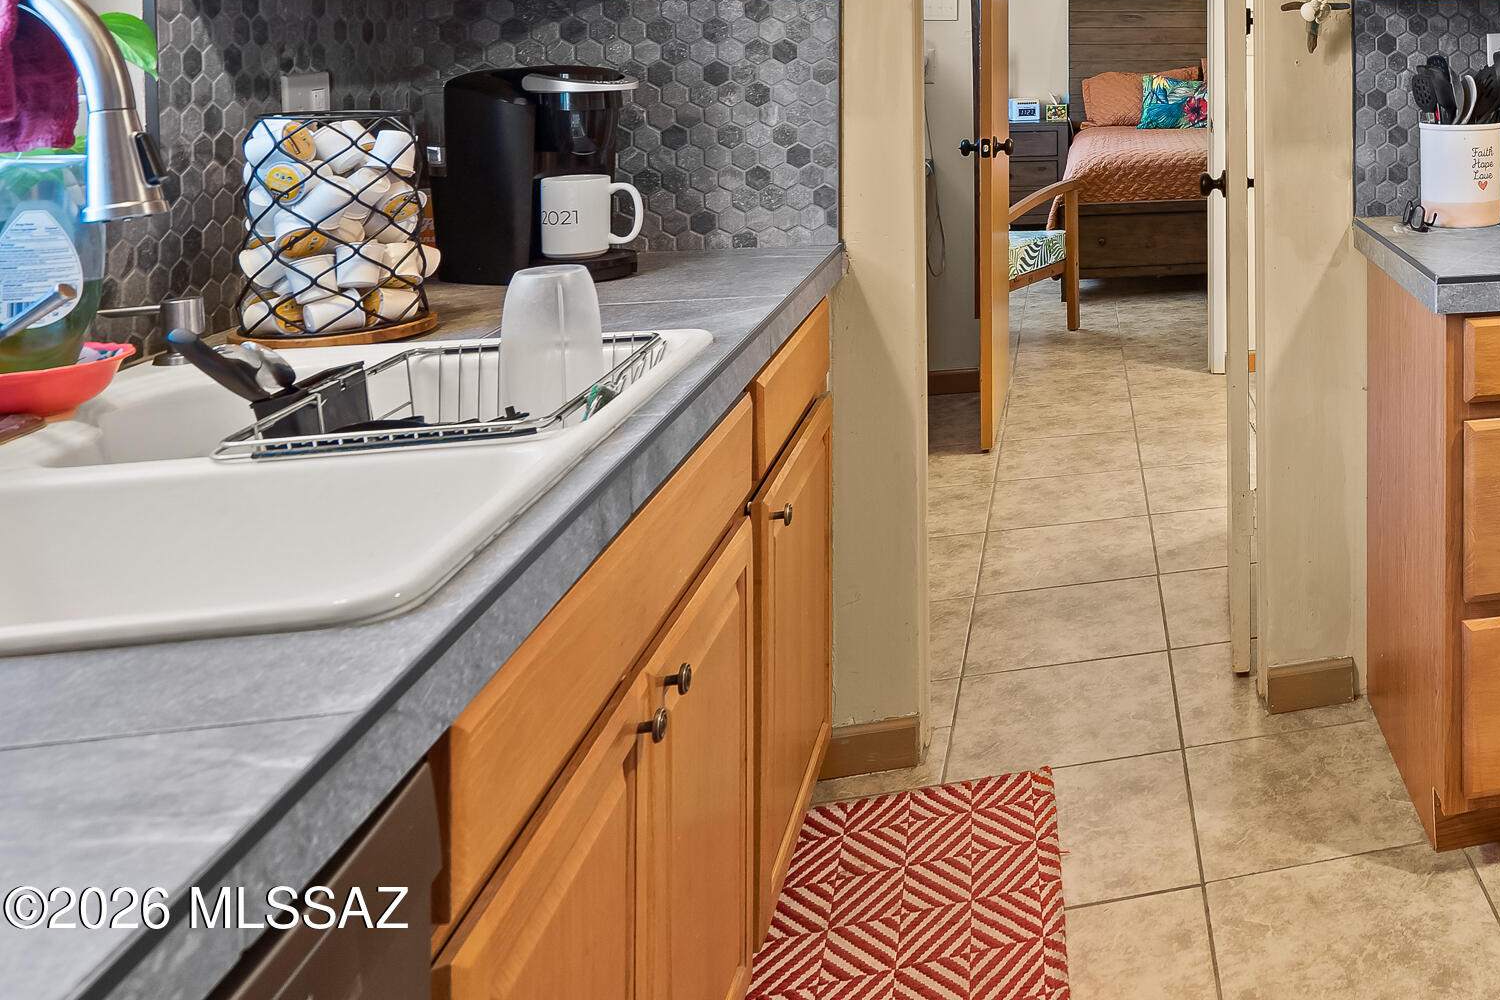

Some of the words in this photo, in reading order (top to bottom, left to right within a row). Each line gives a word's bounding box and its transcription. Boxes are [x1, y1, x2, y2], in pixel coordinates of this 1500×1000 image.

[1471, 145, 1494, 157] Faith
[1471, 158, 1494, 171] Hope
[1473, 169, 1494, 180] Love
[542, 210, 579, 225] 2021
